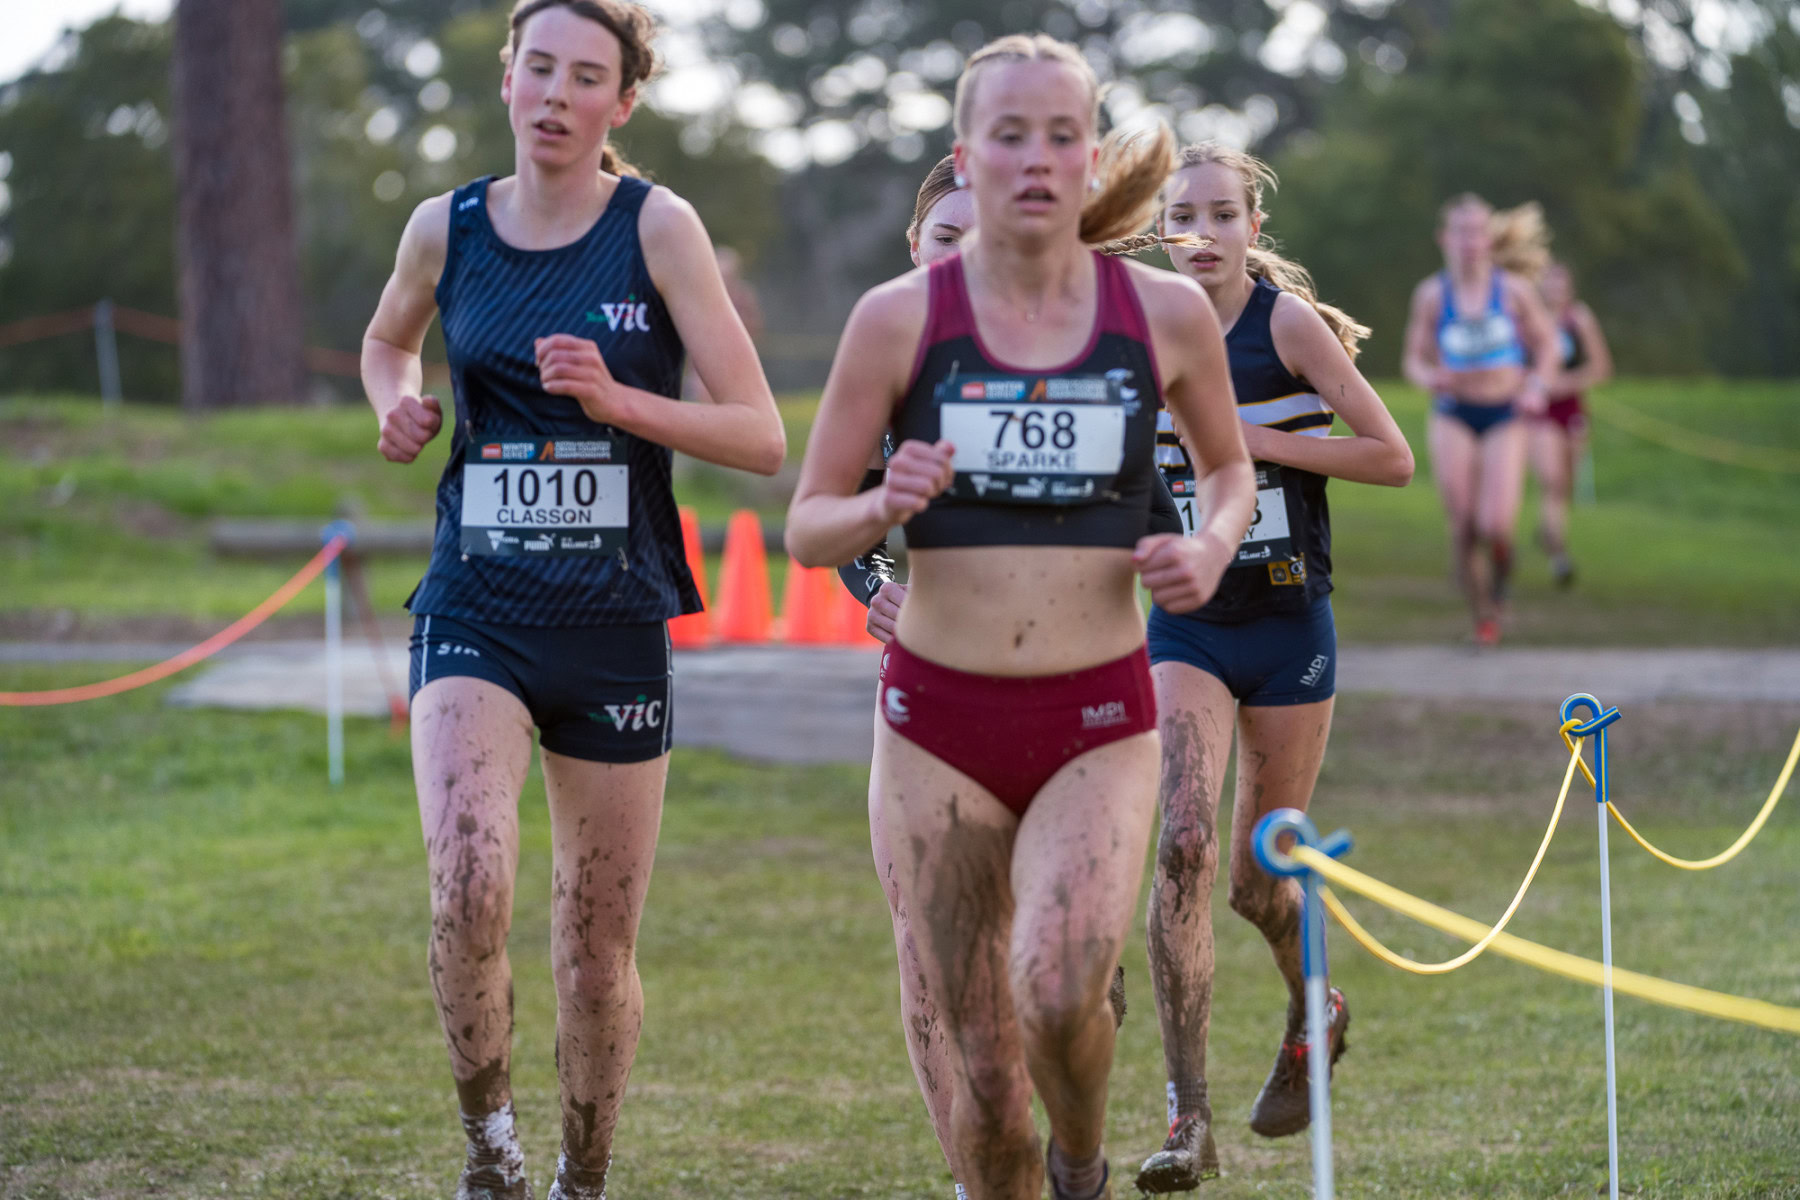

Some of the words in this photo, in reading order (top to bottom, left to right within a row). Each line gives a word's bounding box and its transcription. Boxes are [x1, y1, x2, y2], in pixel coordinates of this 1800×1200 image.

[989, 410, 1077, 450] 768
[987, 452, 1077, 468] SPARKE
[493, 468, 598, 507] 1010
[496, 508, 592, 525] CLASSON
